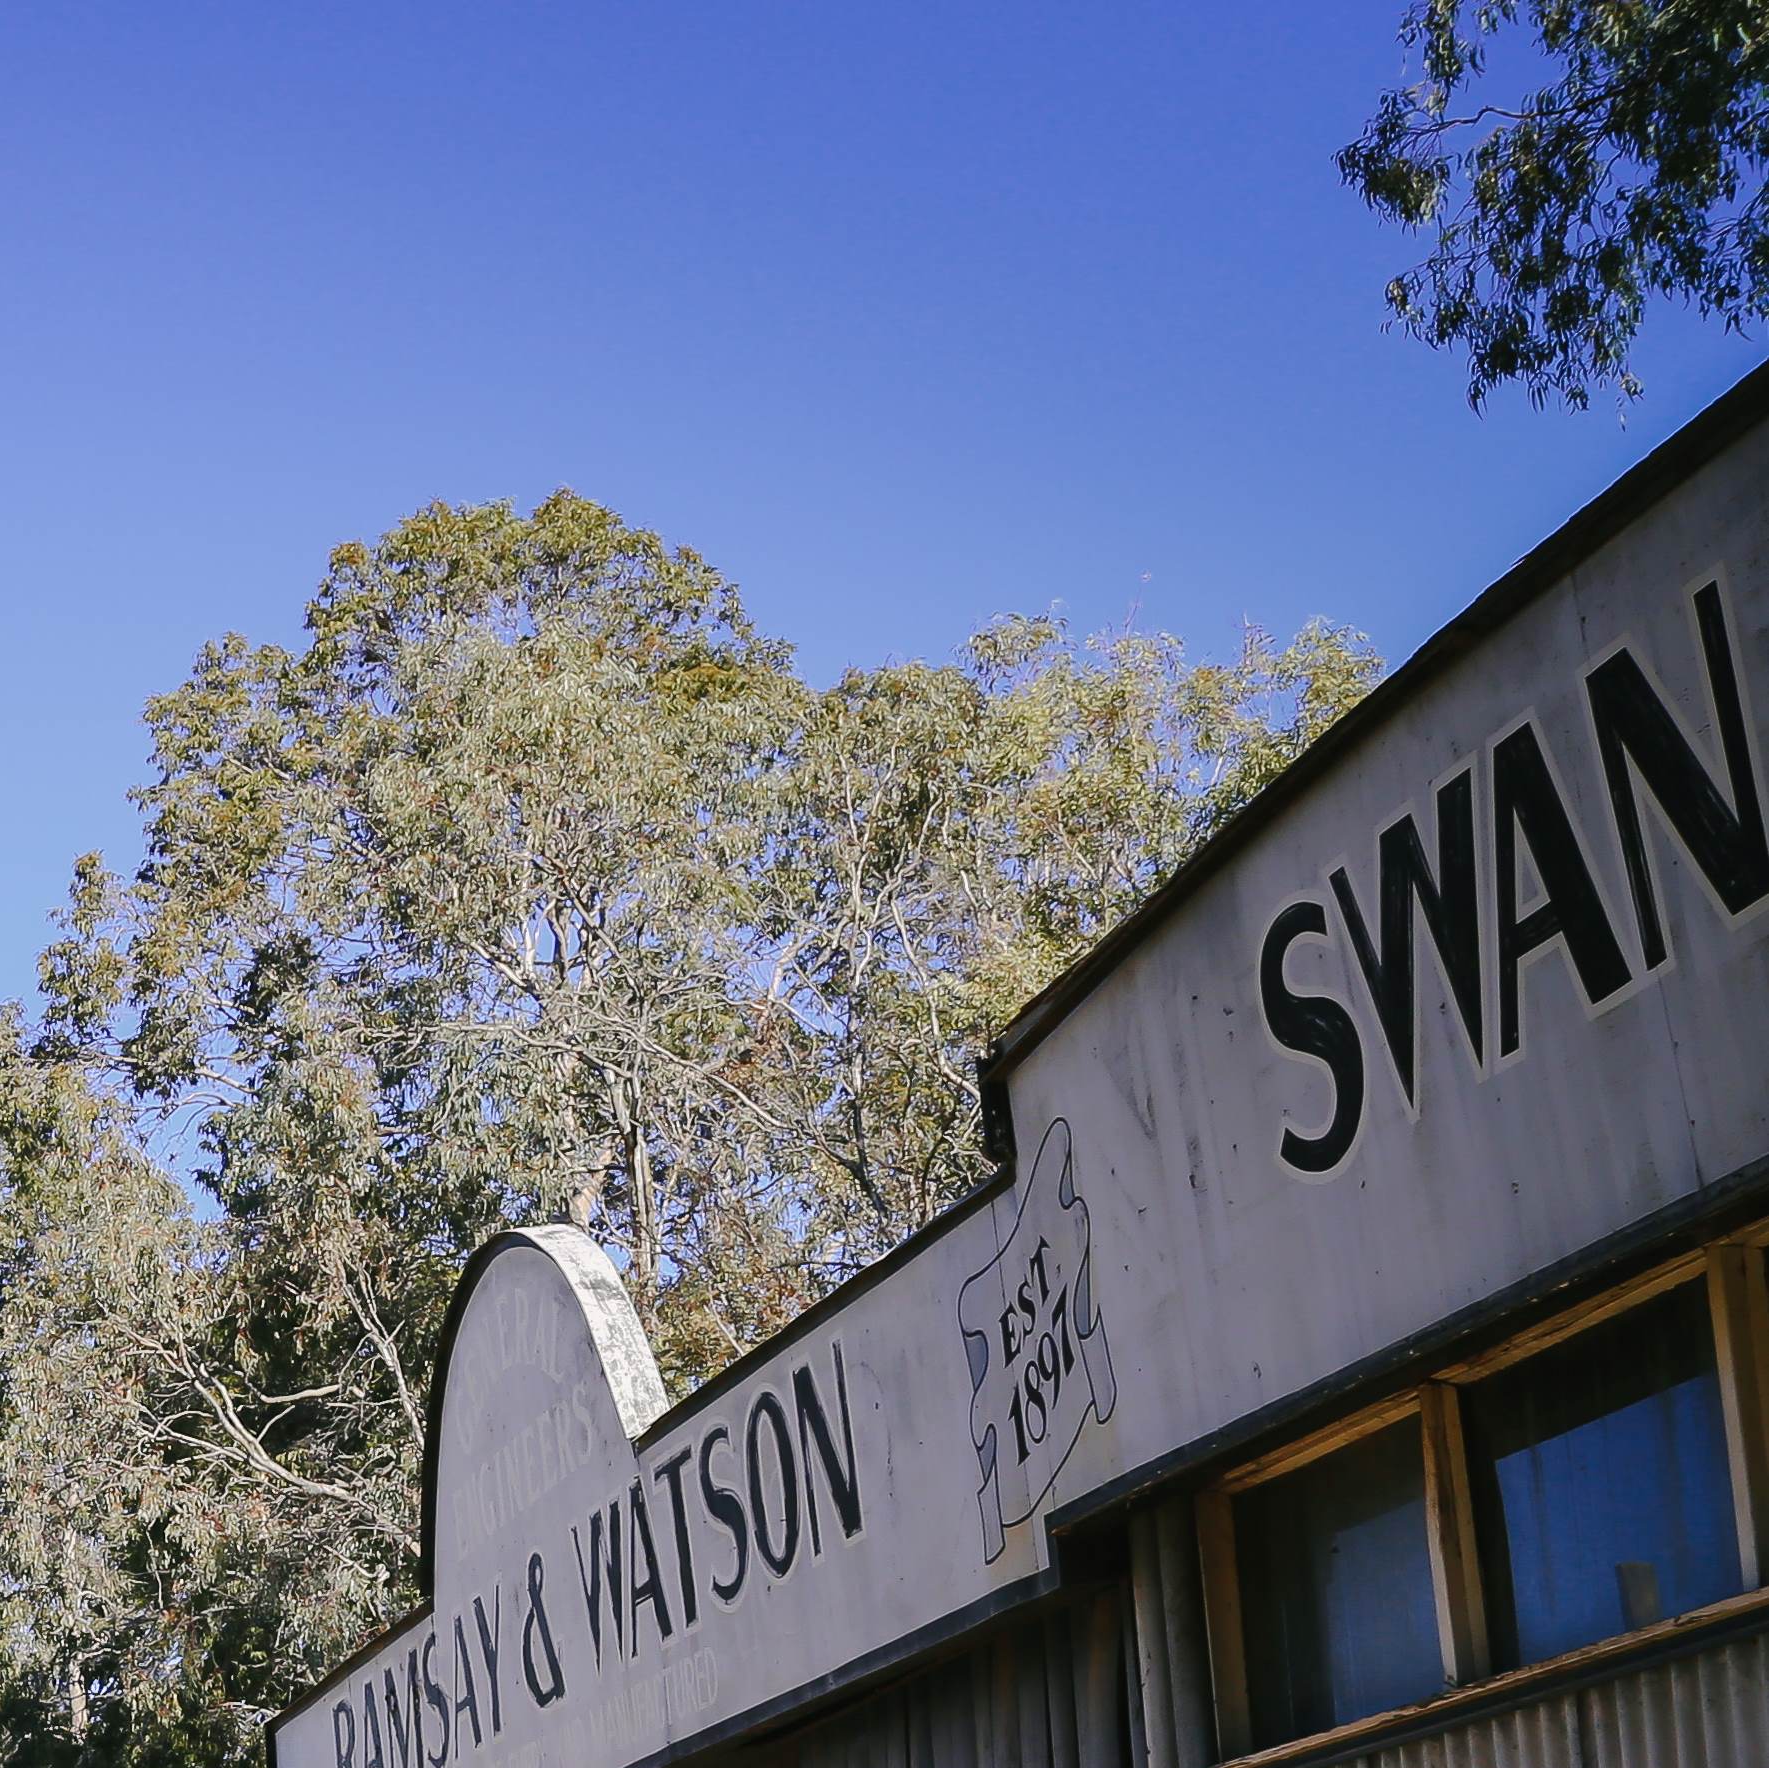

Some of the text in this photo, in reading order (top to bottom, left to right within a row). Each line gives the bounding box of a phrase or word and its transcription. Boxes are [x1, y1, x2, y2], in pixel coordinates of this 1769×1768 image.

[1260, 580, 1769, 1173] SWAN
[522, 1552, 565, 1708] &
[571, 1339, 864, 1673] WATSON
[1009, 1284, 1075, 1467] 1897
